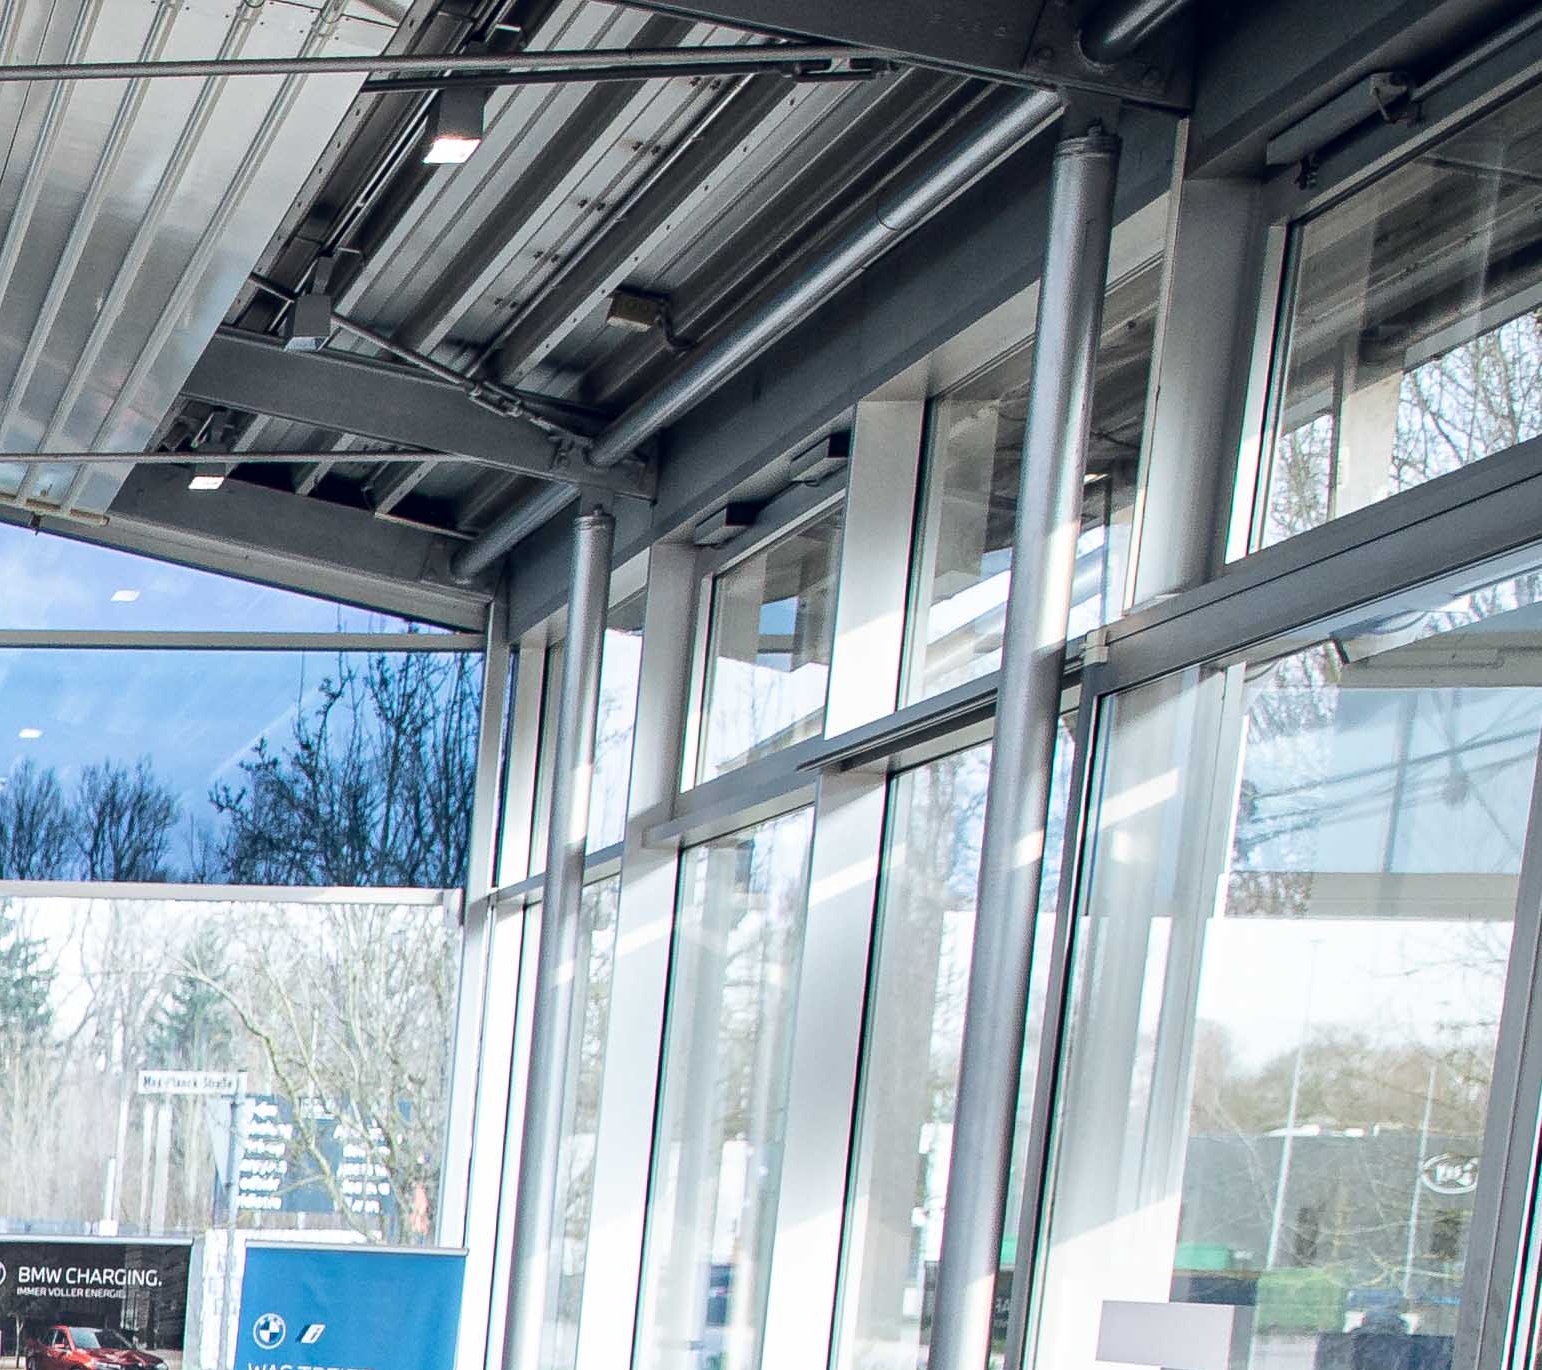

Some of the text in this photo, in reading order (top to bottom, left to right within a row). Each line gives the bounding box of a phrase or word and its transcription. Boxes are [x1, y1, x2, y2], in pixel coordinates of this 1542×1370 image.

[18, 1265, 163, 1288] BMW CHARGING.
[16, 1286, 48, 1297] IMMER
[48, 1287, 84, 1298] VOLLER
